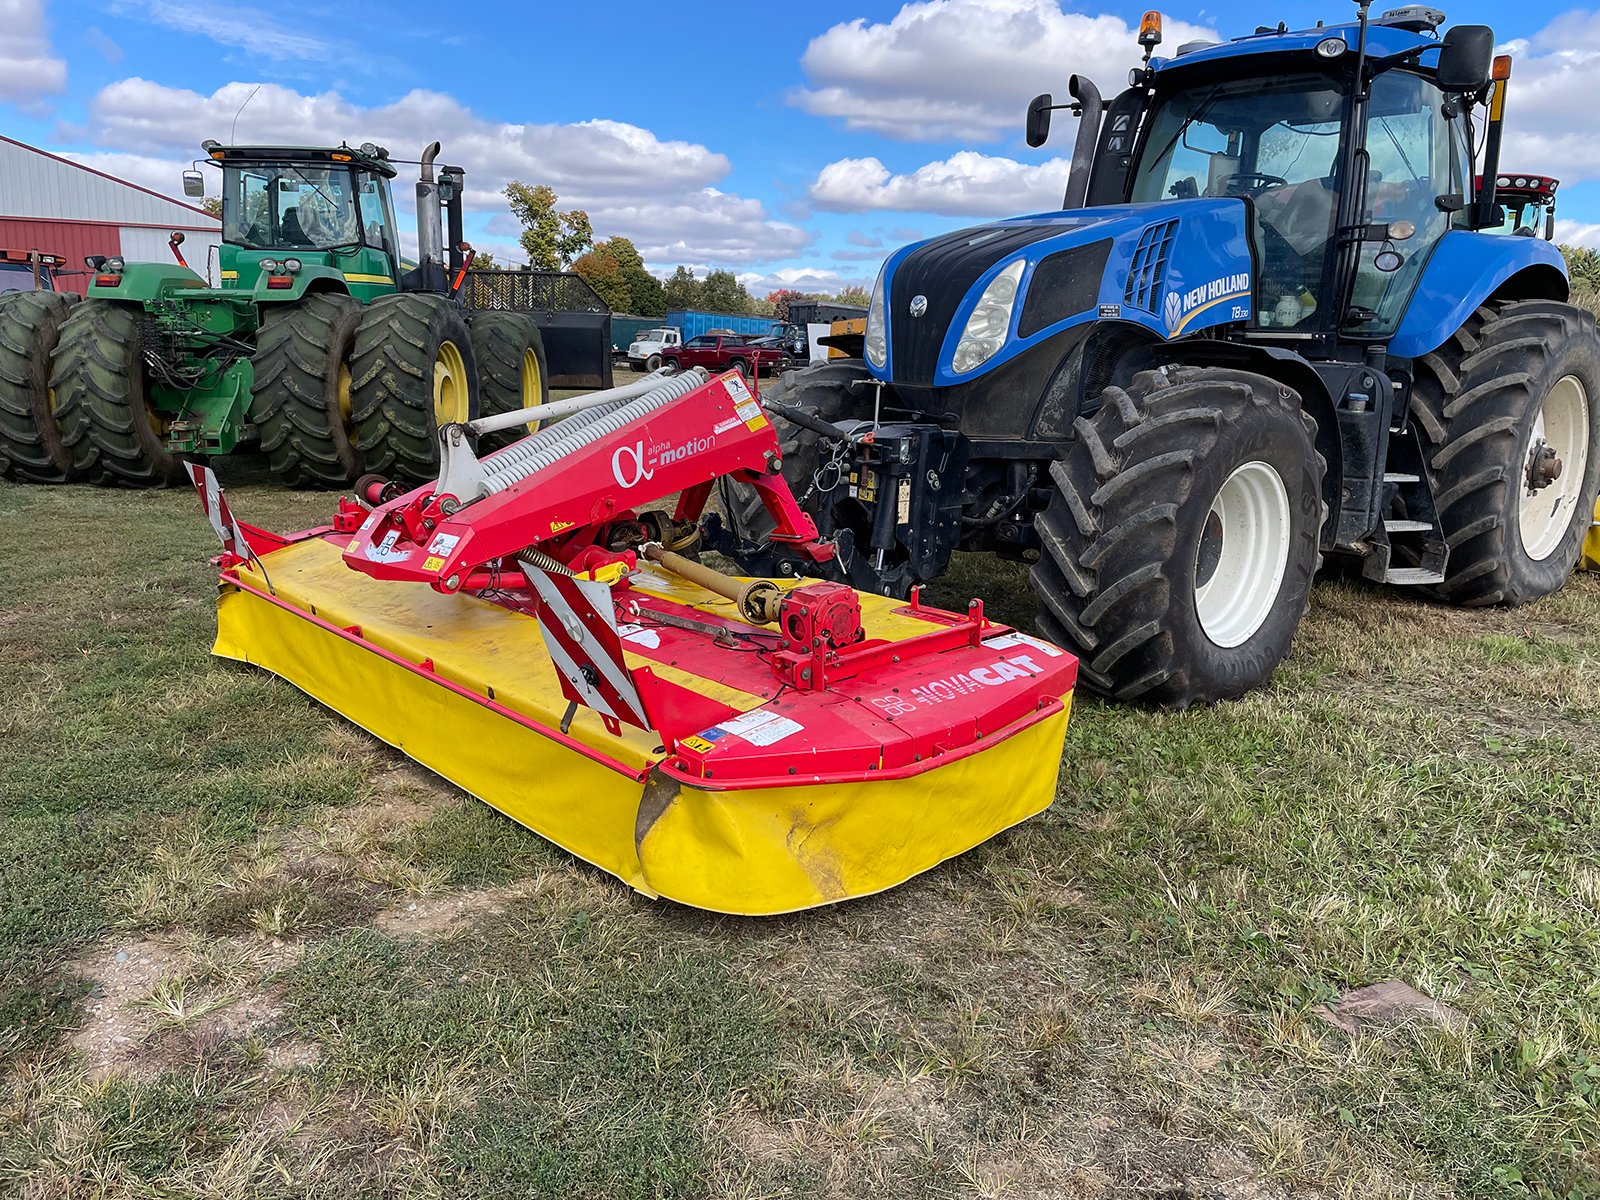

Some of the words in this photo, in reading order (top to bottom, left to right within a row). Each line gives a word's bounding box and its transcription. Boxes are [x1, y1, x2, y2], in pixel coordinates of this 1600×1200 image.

[1183, 284, 1207, 312] NEW
[1208, 273, 1249, 300] HOLLAND
[647, 441, 671, 456] alpha
